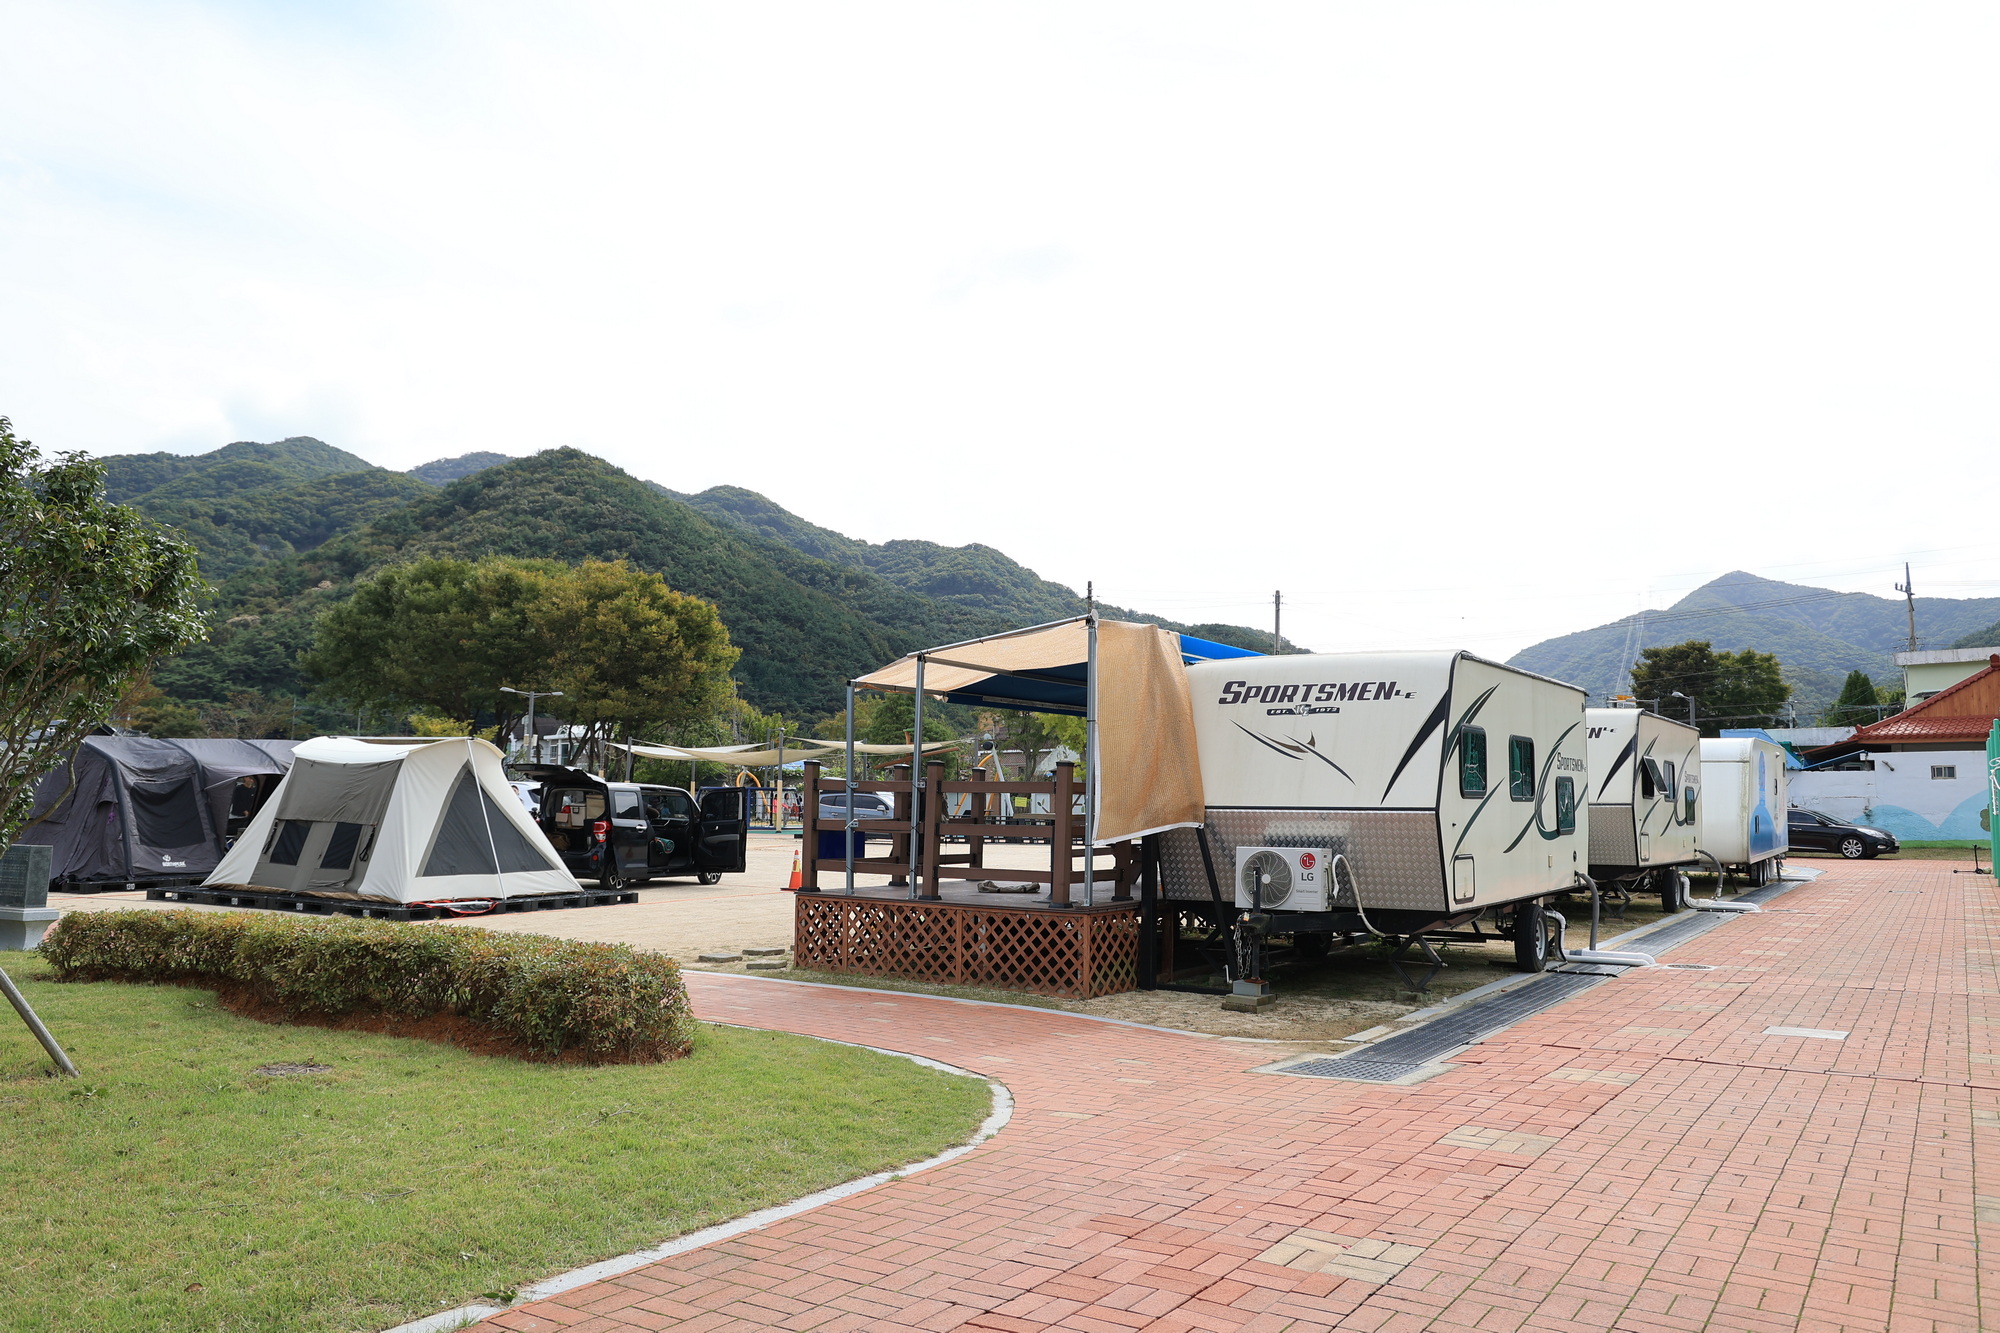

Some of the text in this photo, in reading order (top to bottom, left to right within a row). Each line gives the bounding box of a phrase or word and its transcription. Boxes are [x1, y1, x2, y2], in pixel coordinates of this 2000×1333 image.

[1219, 681, 1417, 704] SPORTSMEN LE
[1557, 752, 1583, 772] SPORTSMEN
[1301, 872, 1314, 882] LG
